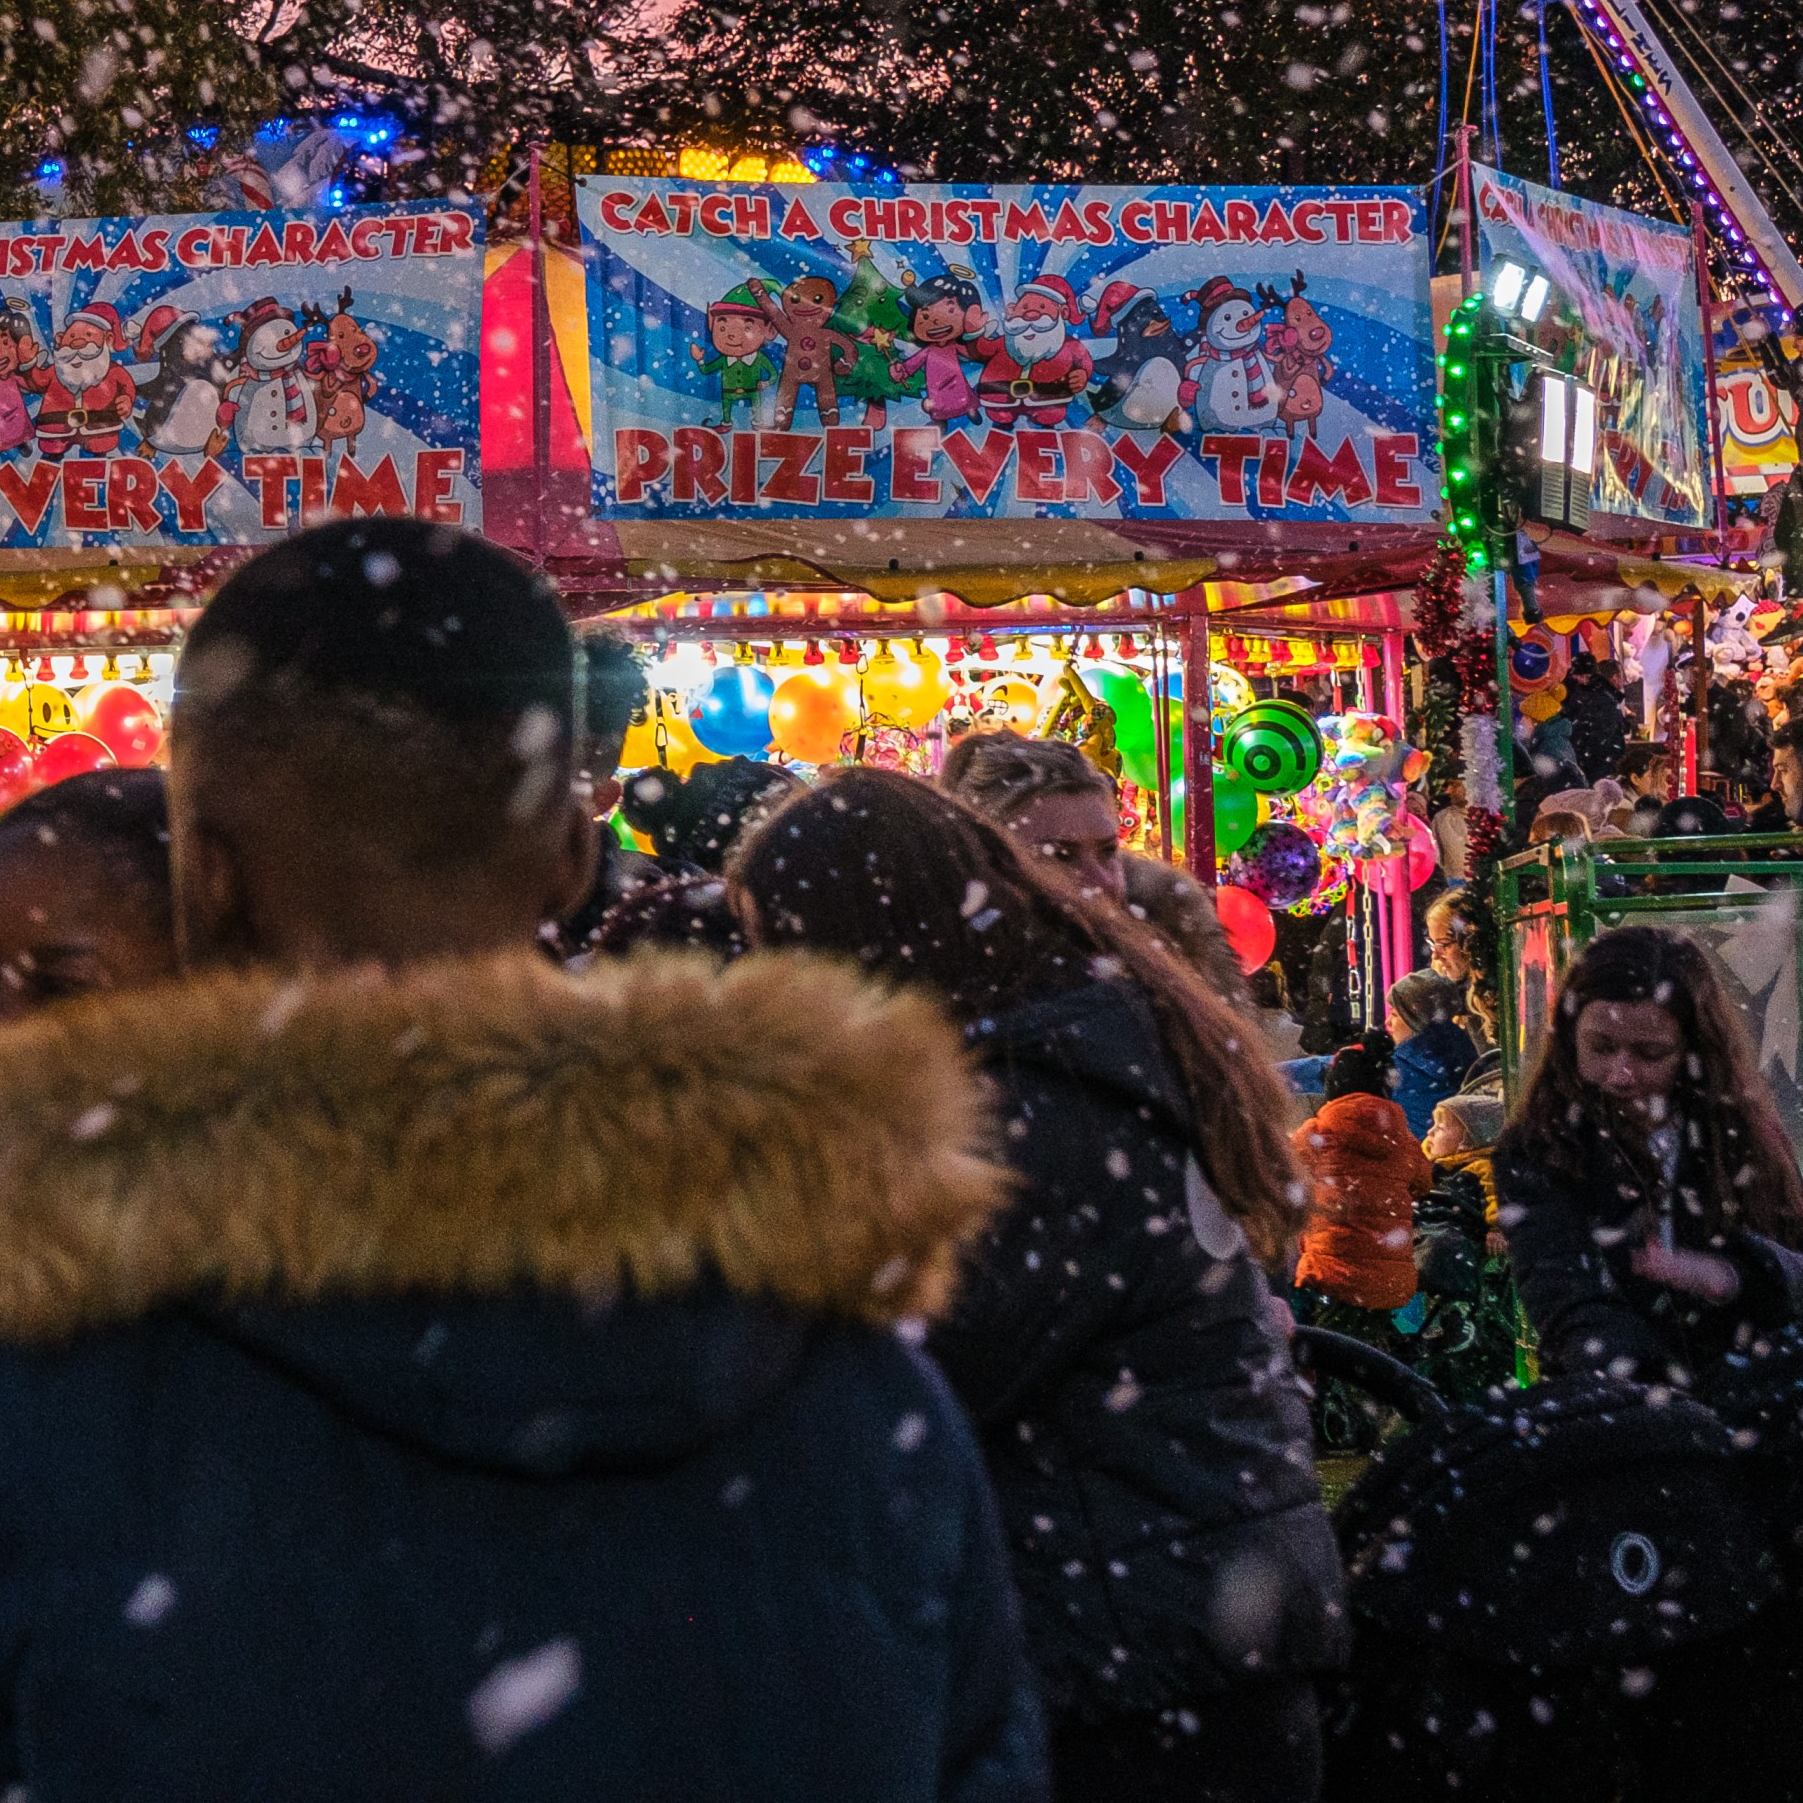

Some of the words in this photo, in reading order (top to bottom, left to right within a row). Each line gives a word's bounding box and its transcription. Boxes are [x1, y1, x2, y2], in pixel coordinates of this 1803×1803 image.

[175, 211, 476, 267] CHARACTER
[600, 192, 772, 239] CATCH
[781, 198, 822, 240] A
[828, 195, 1114, 244] CHRISTMAS
[1119, 198, 1415, 245] CHARACTER
[244, 449, 465, 531] TIME
[613, 425, 878, 506] PRIZE
[892, 428, 1185, 507] EVERY
[1201, 433, 1422, 509] TIME
